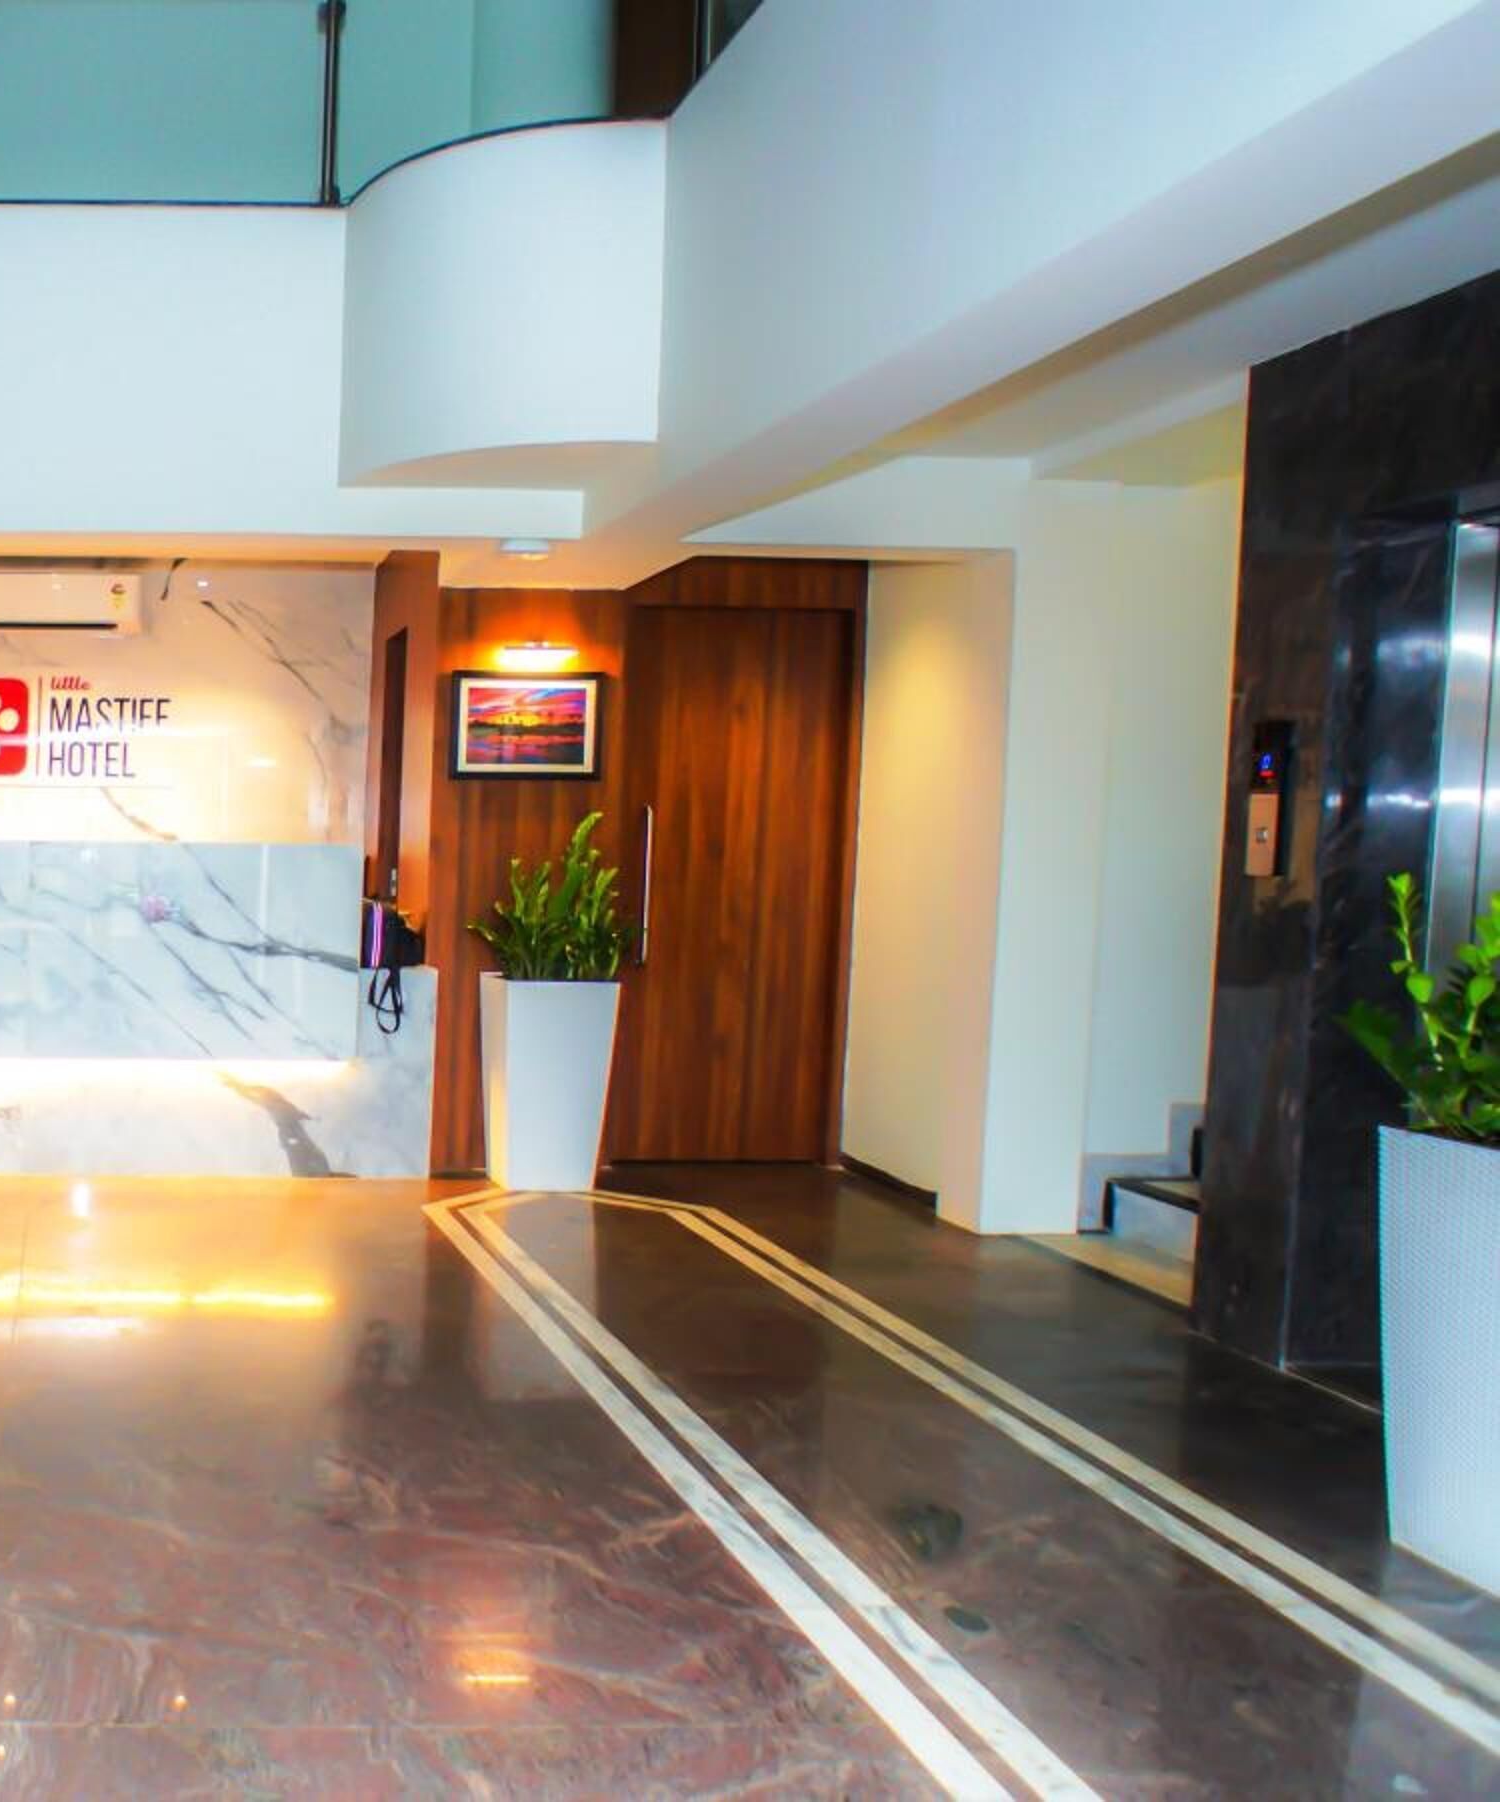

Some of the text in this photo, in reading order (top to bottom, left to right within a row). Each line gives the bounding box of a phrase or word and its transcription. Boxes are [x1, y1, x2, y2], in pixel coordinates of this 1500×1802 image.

[50, 676, 91, 691] little
[49, 697, 172, 733] MASTIFF
[48, 741, 136, 777] HOTEL
